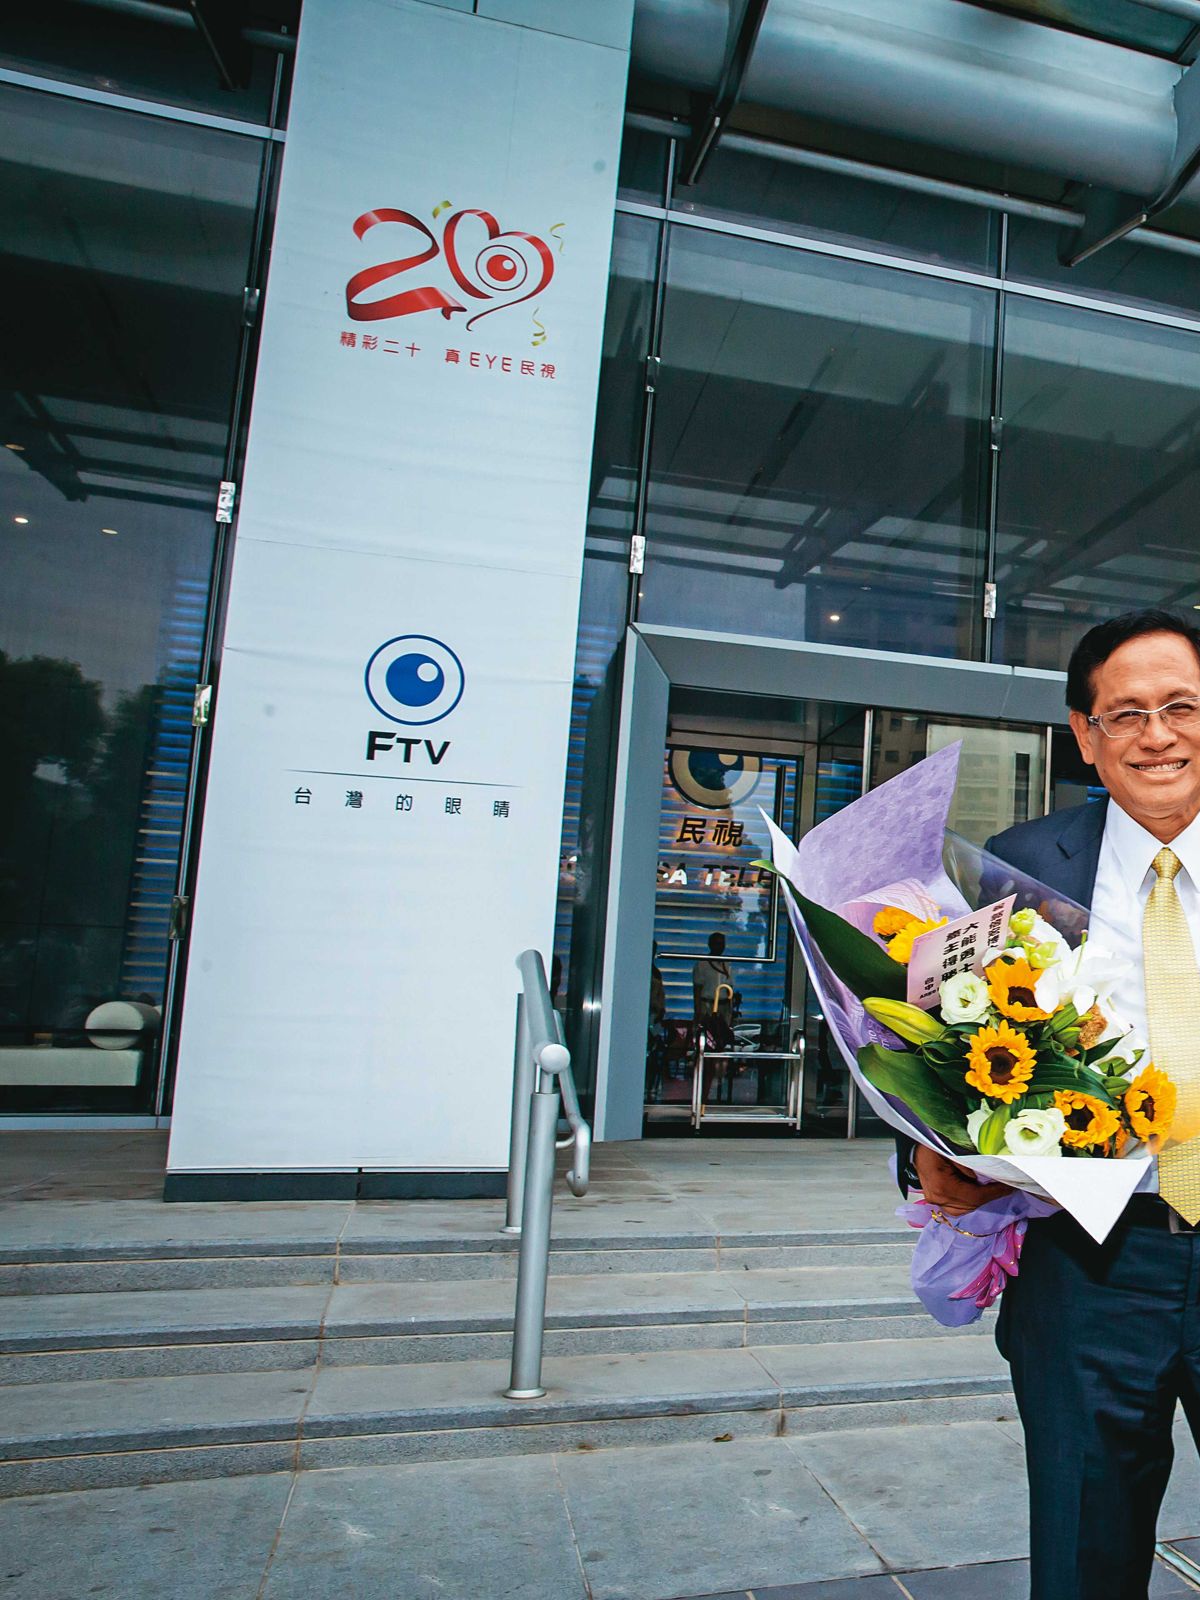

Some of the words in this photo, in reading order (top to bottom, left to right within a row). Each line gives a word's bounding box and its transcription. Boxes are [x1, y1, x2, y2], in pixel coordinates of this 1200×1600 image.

[339, 330, 422, 358] 精彩二十
[443, 347, 556, 380] 真EYE民視
[365, 730, 452, 766] FTV
[294, 786, 511, 819] 台灣的眼睛
[675, 816, 745, 848] 民視
